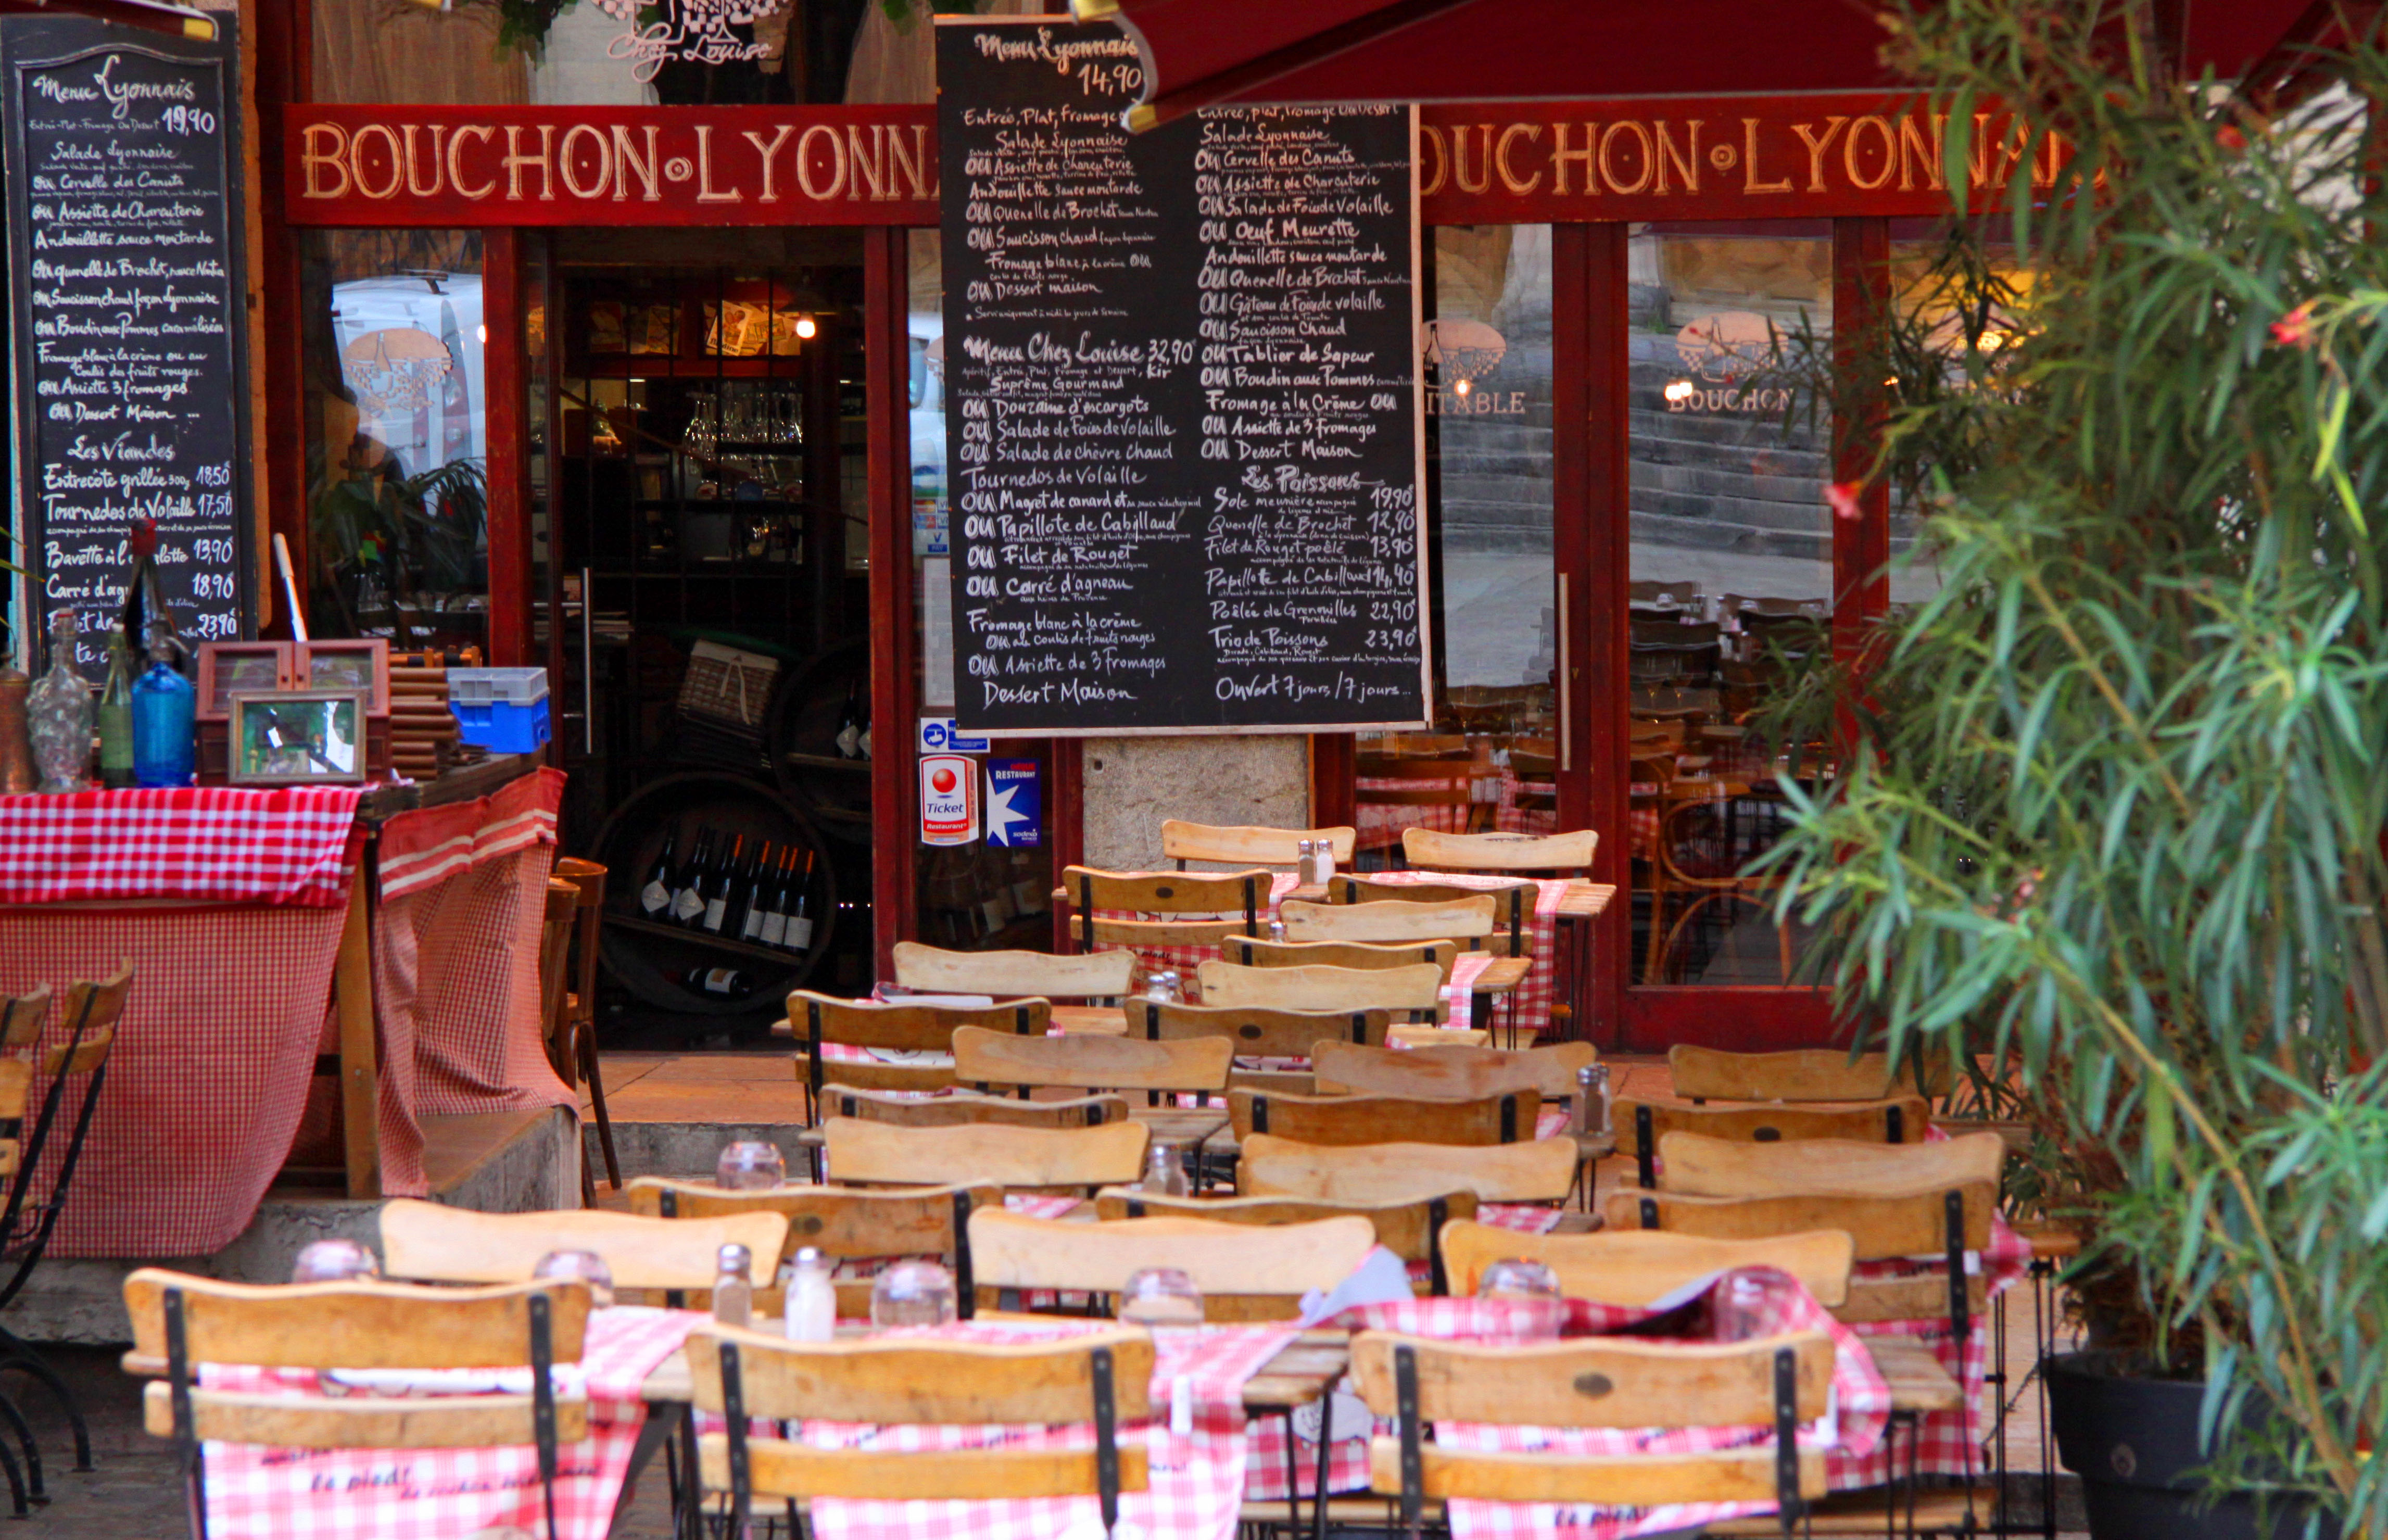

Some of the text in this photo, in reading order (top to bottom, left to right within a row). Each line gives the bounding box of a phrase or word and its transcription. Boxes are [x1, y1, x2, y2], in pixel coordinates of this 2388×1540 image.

[683, 35, 773, 65] Louise
[974, 26, 1139, 75] Menu Lyonnais
[33, 54, 196, 120] Menu Lyonnais
[1077, 63, 1142, 96] 14,90
[161, 105, 215, 137] 19,90
[995, 130, 1128, 158] Salade Lyonnaise
[1199, 122, 1253, 145] Salade
[1255, 122, 1330, 149] Lyonnaise
[50, 138, 180, 166] Salade Lyonnaise
[301, 122, 939, 204] BOUCHON LYONN
[1224, 148, 1275, 168] Cervelle
[1302, 144, 1355, 166] Canuts
[1420, 118, 1704, 196] OUCHON
[994, 158, 1044, 176] Assiette
[969, 179, 1143, 202] Andouillette moutarde
[1224, 174, 1280, 192] Assiette
[58, 200, 110, 222] Assiette
[993, 198, 1119, 223] Quenelle Brochet
[1225, 197, 1275, 218] Salade
[1336, 193, 1394, 216] Volaille
[34, 229, 215, 249] Andouillette sauce moutarde
[996, 225, 1059, 248] Saucisson
[1282, 217, 1360, 238] Meurette
[985, 250, 1081, 273] Fromage blanc
[1205, 246, 1286, 267] Andouillette
[1290, 251, 1322, 262] sauce
[1325, 243, 1387, 262] moutarde
[1230, 266, 1295, 288] Quenelle
[995, 280, 1103, 301] Dessert maison
[55, 313, 103, 337] Boudin
[1229, 320, 1295, 341] Saucisson
[963, 334, 1026, 365] Menu
[1028, 331, 1072, 369] Chez
[1075, 330, 1145, 363] Louise
[1228, 343, 1374, 369] Tablier Sapeur
[1053, 376, 1124, 391] Gourmand
[1146, 363, 1172, 380] Kir
[1233, 364, 1375, 392] Boudin Pommes
[60, 376, 109, 396] Assiette
[112, 381, 122, 395] 3
[992, 394, 1149, 420] Douzaine d'escargots
[1205, 390, 1277, 415] Fromage
[1425, 392, 1526, 415] ITABLE
[1669, 387, 1794, 413] BOUCHON
[74, 401, 176, 425] Dessert Maison
[1231, 415, 1282, 436] Assiette
[997, 419, 1050, 441] Salade
[67, 431, 176, 461] Les Viandes
[995, 441, 1050, 462] Salade
[1235, 438, 1363, 461] Dessert Maison
[43, 463, 118, 489] Entrecôte
[120, 466, 168, 499] grillée
[960, 465, 1147, 490] Tournedos Volaille
[1241, 464, 1382, 494] Les Poissons
[43, 493, 125, 522] Tournedos
[146, 491, 196, 519] Volaille
[1000, 490, 1051, 516] Magret
[1069, 490, 1111, 509] canard
[1214, 487, 1250, 513] Sole
[1256, 495, 1315, 507] meunière
[997, 513, 1071, 540] Papillote
[1101, 510, 1177, 532] Cabillaud
[1207, 515, 1268, 538] Quenelle
[1298, 516, 1357, 532] Brochet
[45, 540, 104, 569] Bavette
[1001, 542, 1139, 569] Filet Rouget
[1204, 535, 1240, 561] Filet
[1255, 539, 1301, 559] Rouget
[46, 574, 91, 599] Carré
[1006, 573, 1133, 596] Carré d'agneau
[1204, 567, 1278, 595] Papillote
[1304, 565, 1371, 587] Cabillaud
[1210, 600, 1260, 621] Poêlée
[1284, 599, 1357, 618] Grenouilles
[967, 608, 1143, 638] Fromage blanc crème
[1208, 625, 1242, 648] Trio
[1261, 627, 1329, 647] Poissons
[1005, 646, 1166, 678] Assiette 3 Fromages
[983, 677, 1138, 711] Dessert Maison
[1216, 674, 1280, 701] Ouvert
[995, 771, 1035, 780] RESTAURANT
[927, 803, 964, 814] Ticket
